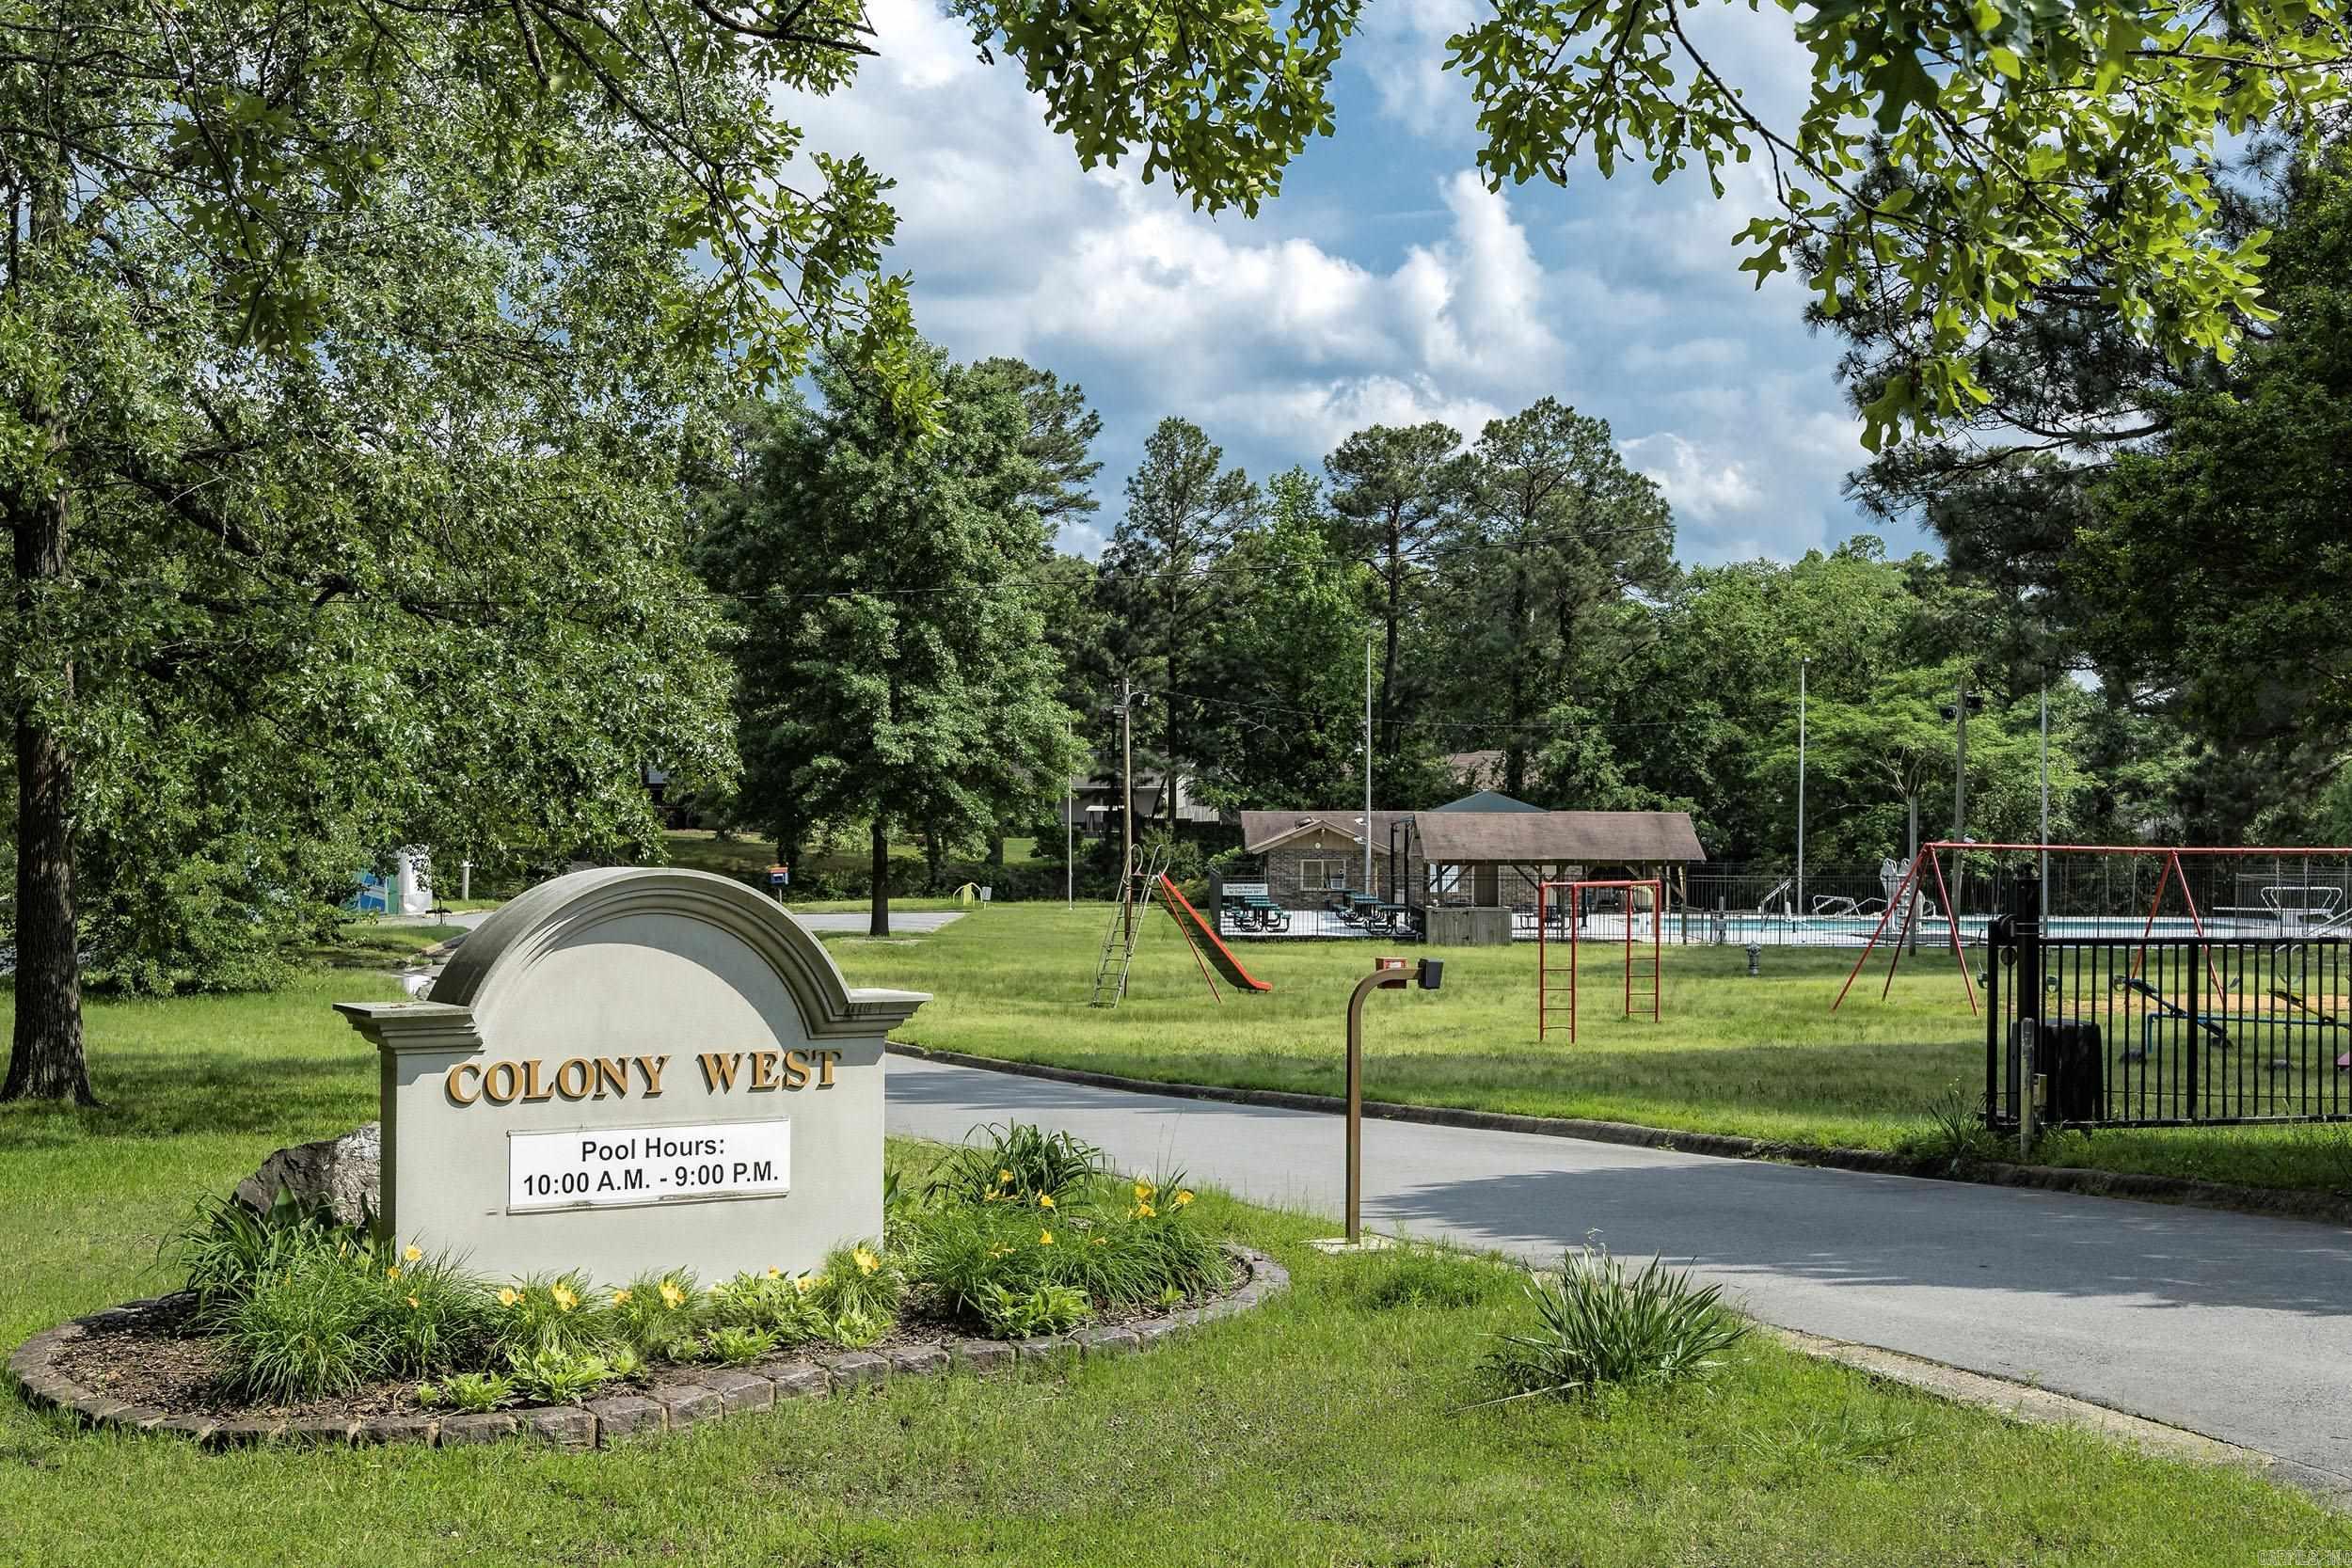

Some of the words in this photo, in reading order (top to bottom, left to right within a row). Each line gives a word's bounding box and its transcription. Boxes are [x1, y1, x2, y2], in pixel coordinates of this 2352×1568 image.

[446, 1054, 671, 1106] COLONY
[694, 1048, 842, 1095] WEST
[581, 1138, 636, 1163] Pool
[645, 1135, 724, 1159] Hours:
[523, 1172, 590, 1196] 10:00
[596, 1168, 650, 1192] A.M.
[675, 1164, 724, 1187] 9:00
[733, 1161, 779, 1183] P.M.
